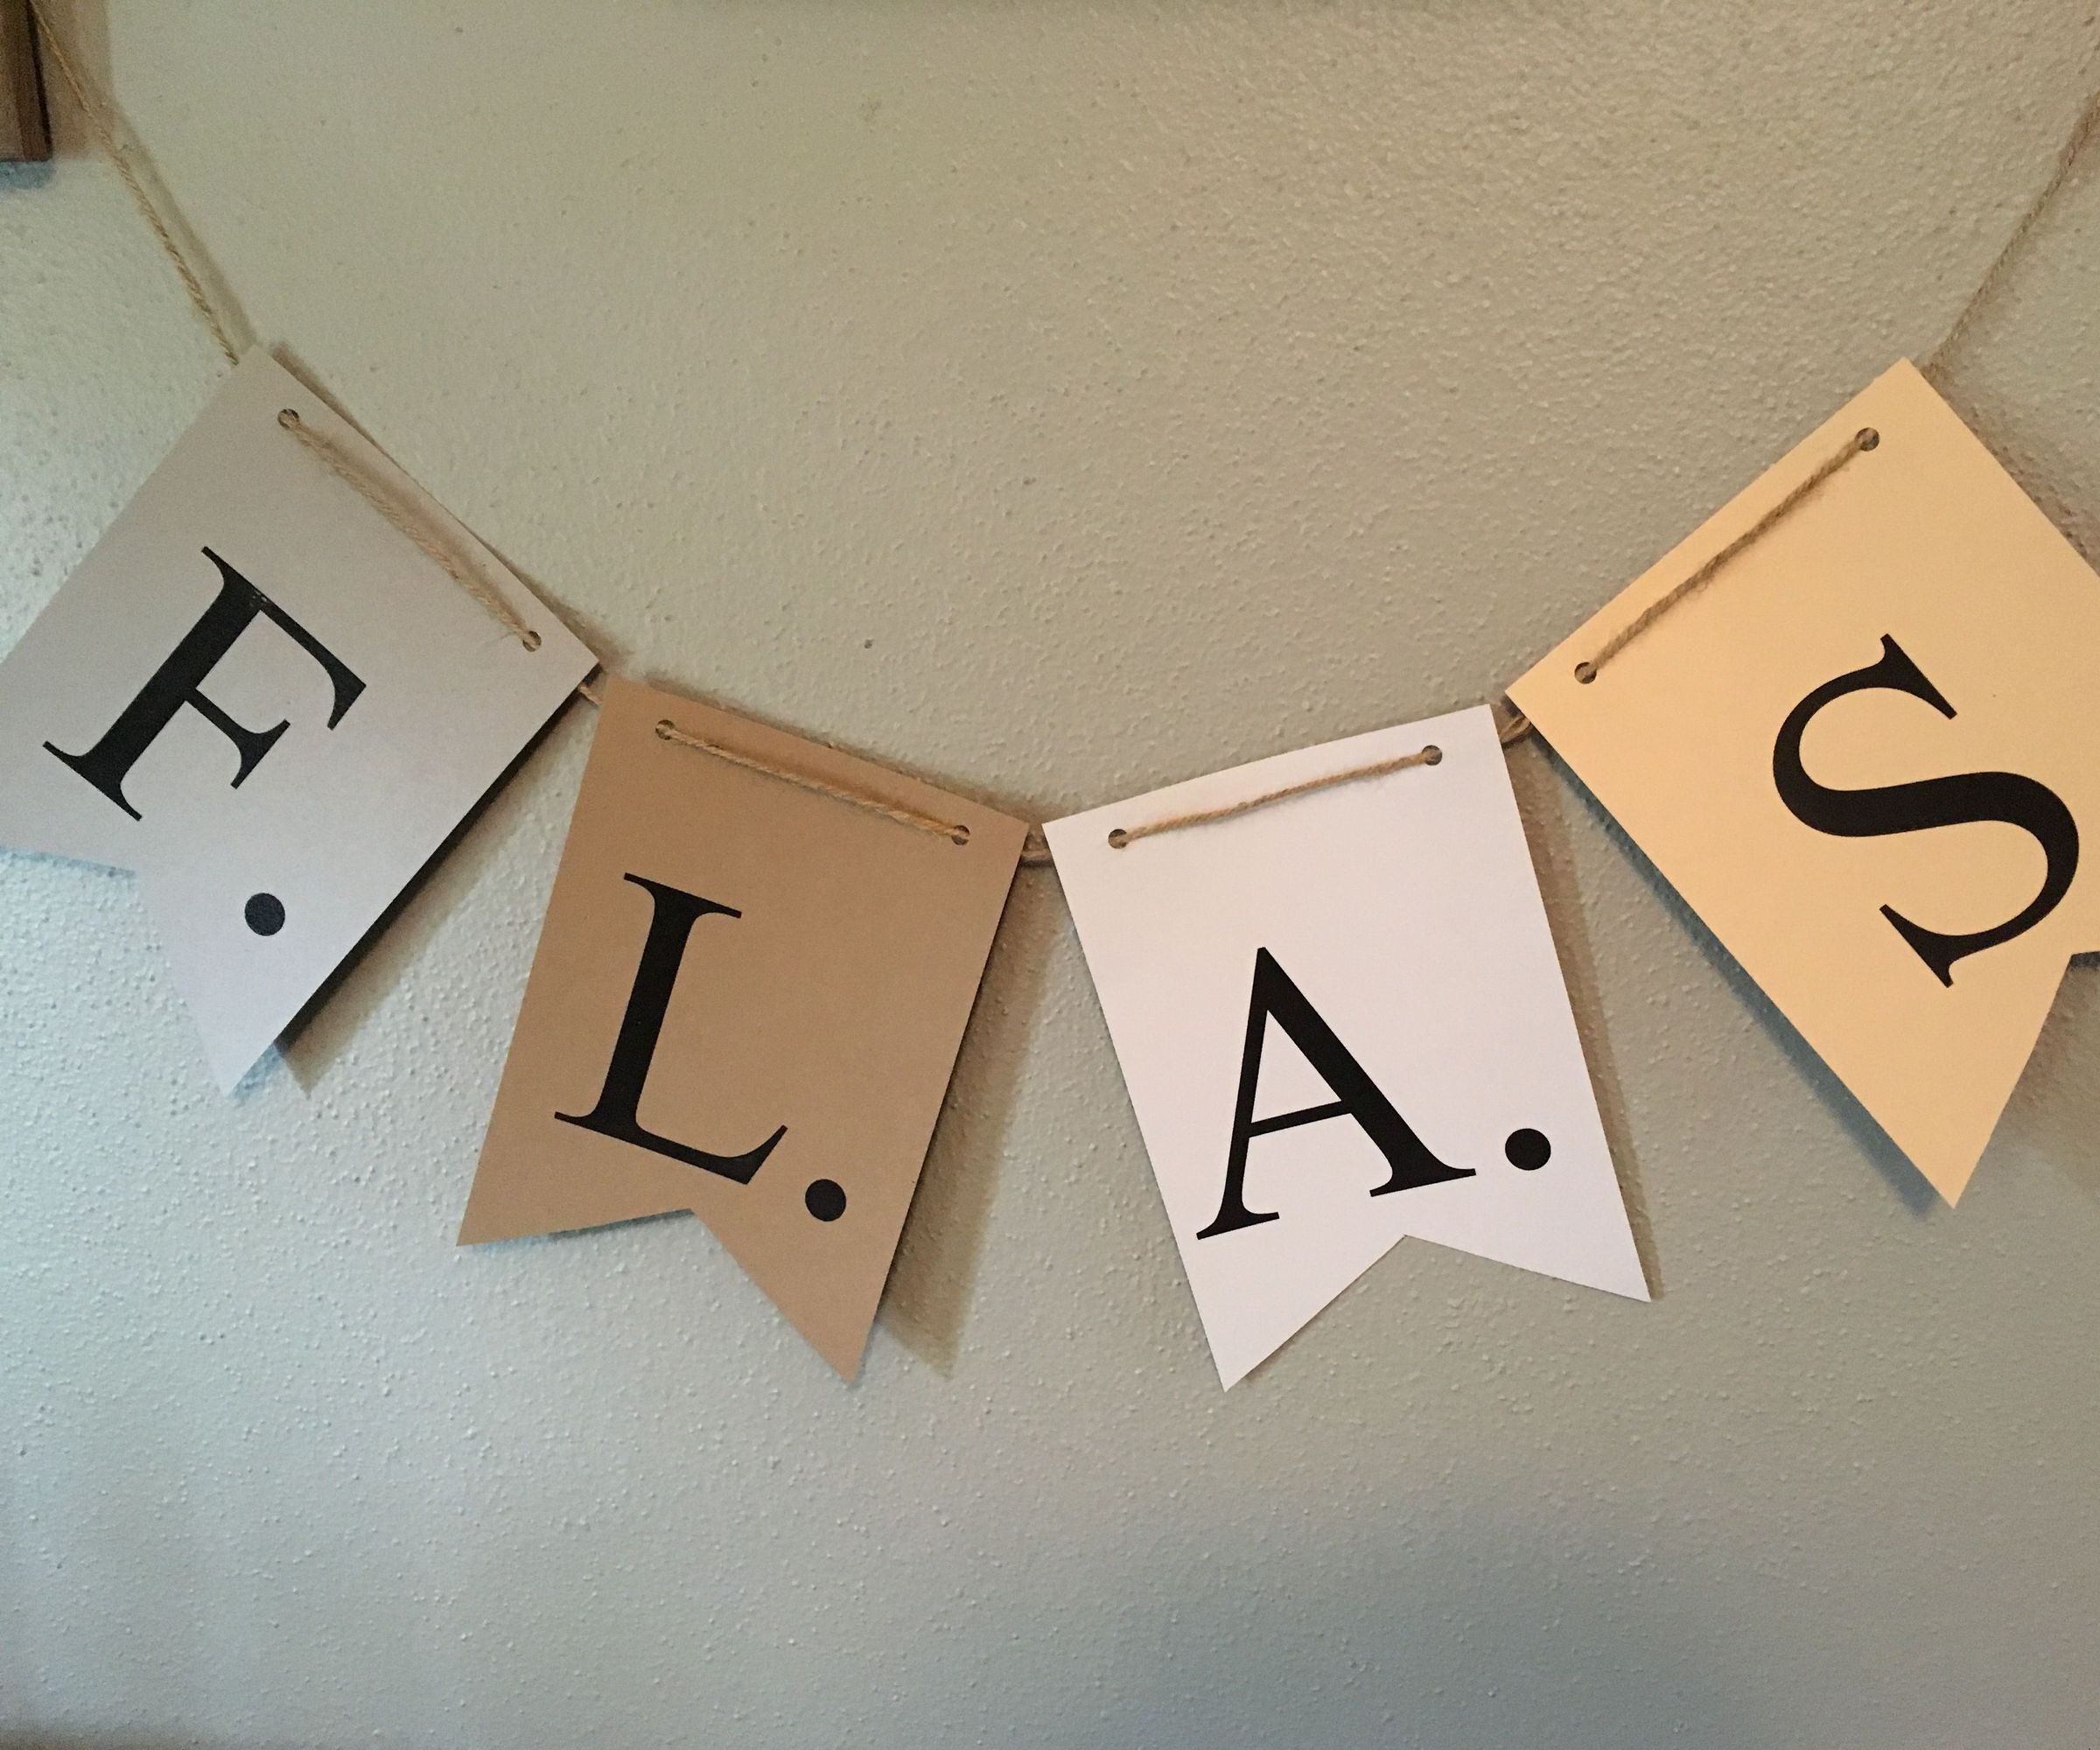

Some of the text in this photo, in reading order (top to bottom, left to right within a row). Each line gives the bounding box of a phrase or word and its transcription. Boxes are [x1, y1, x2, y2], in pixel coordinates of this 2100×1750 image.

[43, 547, 366, 936] F.
[1773, 634, 2079, 988] S
[555, 872, 847, 1222] L.
[1197, 948, 1551, 1241] A.
